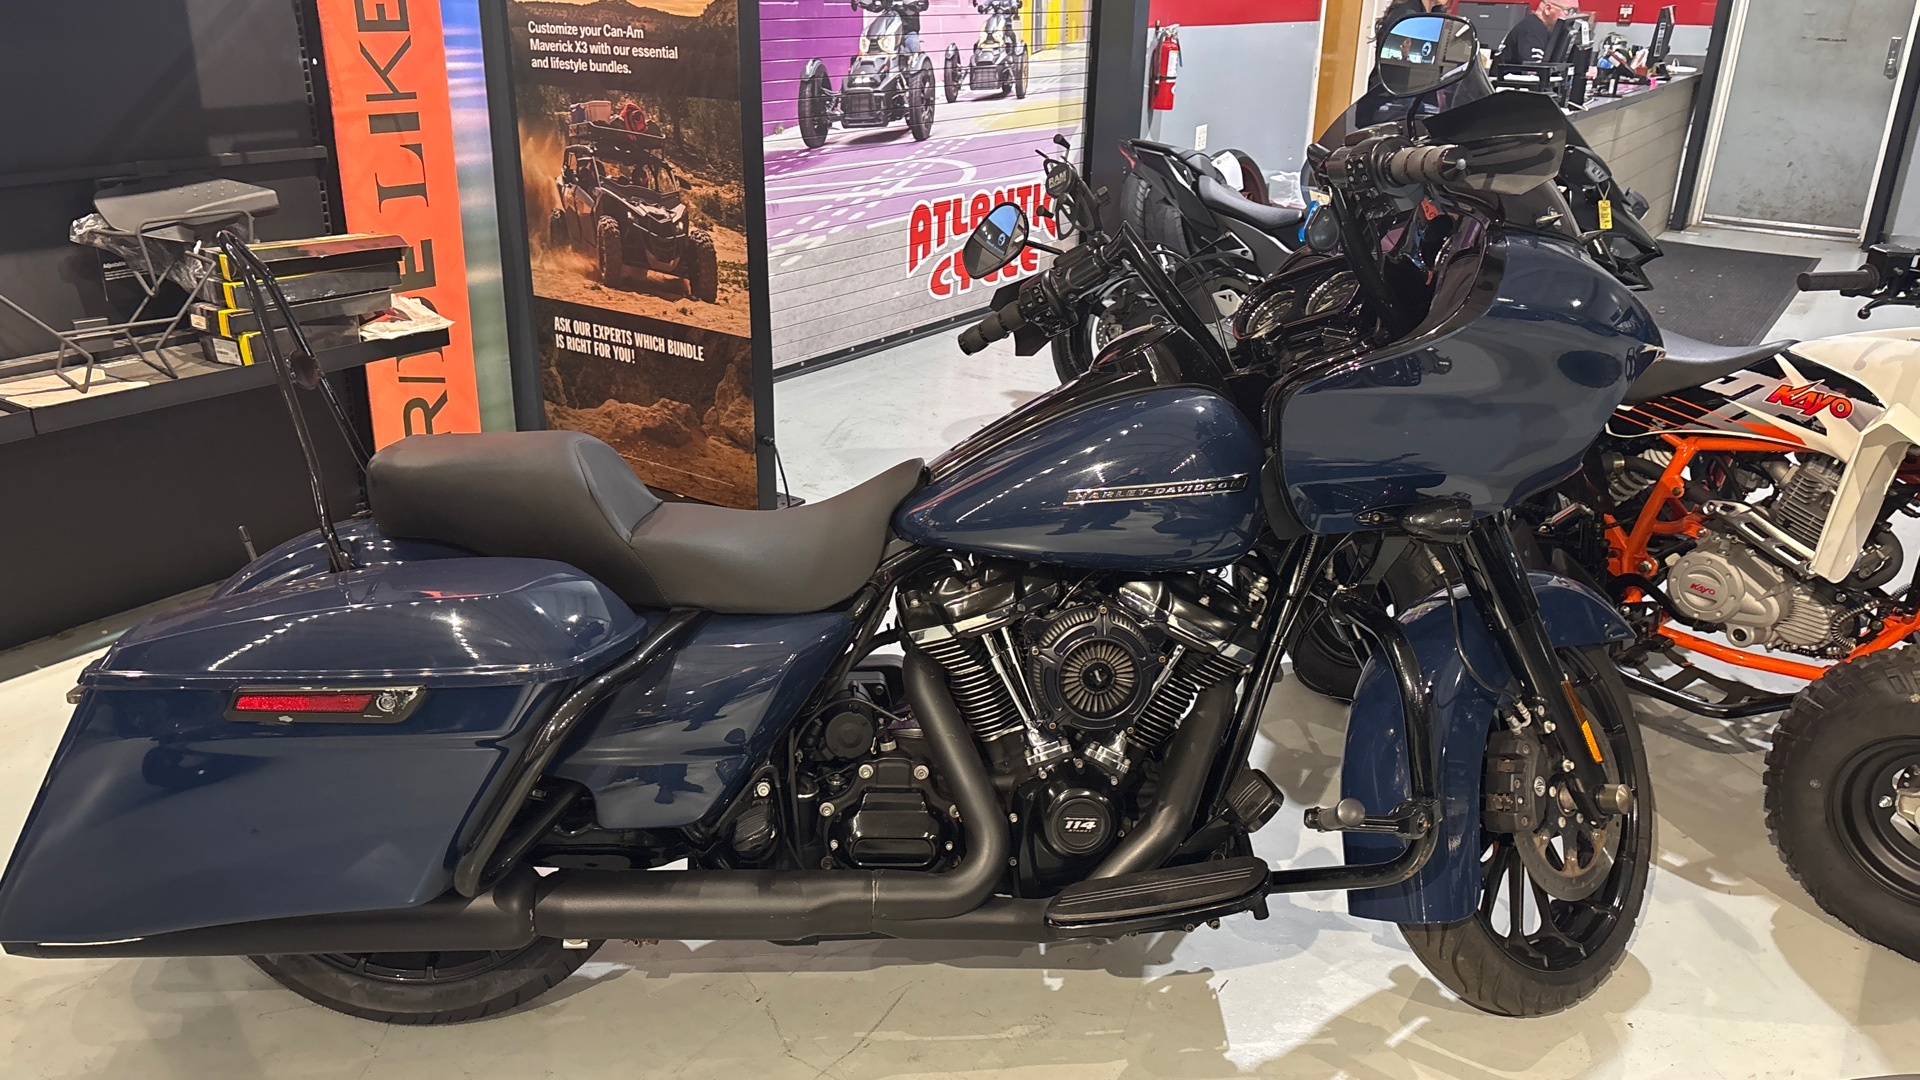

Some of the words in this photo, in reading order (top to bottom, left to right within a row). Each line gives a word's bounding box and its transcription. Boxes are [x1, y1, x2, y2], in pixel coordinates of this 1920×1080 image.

[528, 21, 578, 35] Customize
[580, 24, 601, 38] your
[603, 24, 644, 39] Can-Am
[530, 38, 573, 53] Maverick
[575, 41, 588, 54] X3
[589, 42, 612, 55] with
[613, 46, 631, 56] our
[632, 46, 678, 60] essential
[531, 57, 549, 69] and
[550, 57, 588, 73] lifestyle
[589, 59, 632, 74] bundles.
[353, 0, 428, 213] LIKE
[1048, 169, 1067, 186] RAM
[391, 239, 450, 438] RIE
[554, 316, 572, 333] ASK
[573, 320, 591, 337] OUR
[593, 324, 633, 346] EXPERTS
[634, 332, 666, 353] WHICH
[667, 339, 705, 361] BUNDLE
[555, 333, 565, 349] IS
[566, 336, 592, 355] RIGHT
[594, 342, 611, 359] FOR
[612, 345, 636, 364] YOU!
[1765, 379, 1853, 419] KAYO
[1075, 480, 1242, 501] HARLEY-DAVIDSON
[1065, 820, 1097, 830] 114
